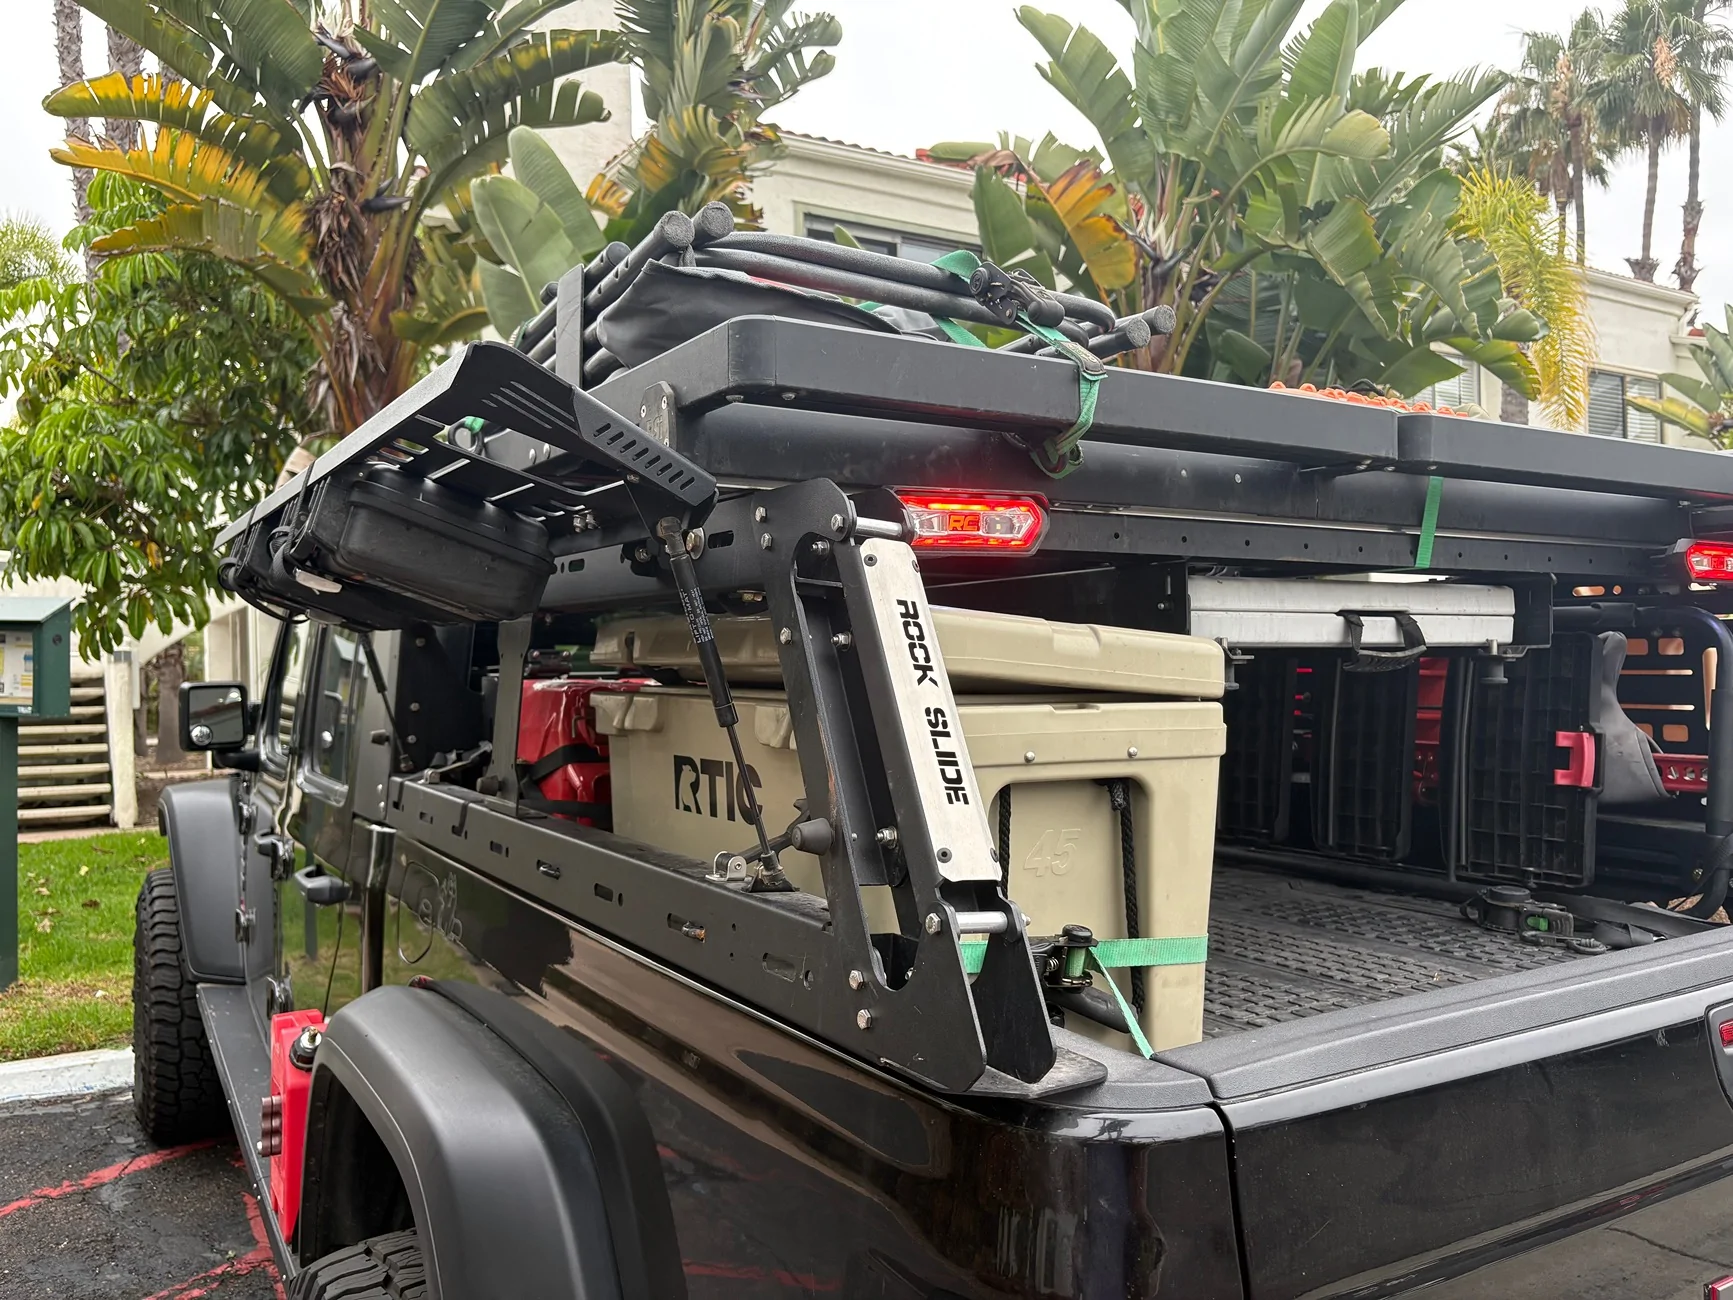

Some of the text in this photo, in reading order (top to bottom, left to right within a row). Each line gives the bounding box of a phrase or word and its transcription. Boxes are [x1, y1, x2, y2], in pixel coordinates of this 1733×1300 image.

[949, 515, 980, 531] RC
[896, 599, 970, 804] ROCK SLIDE
[673, 754, 763, 825] RTIC
[1023, 828, 1081, 877] 45
